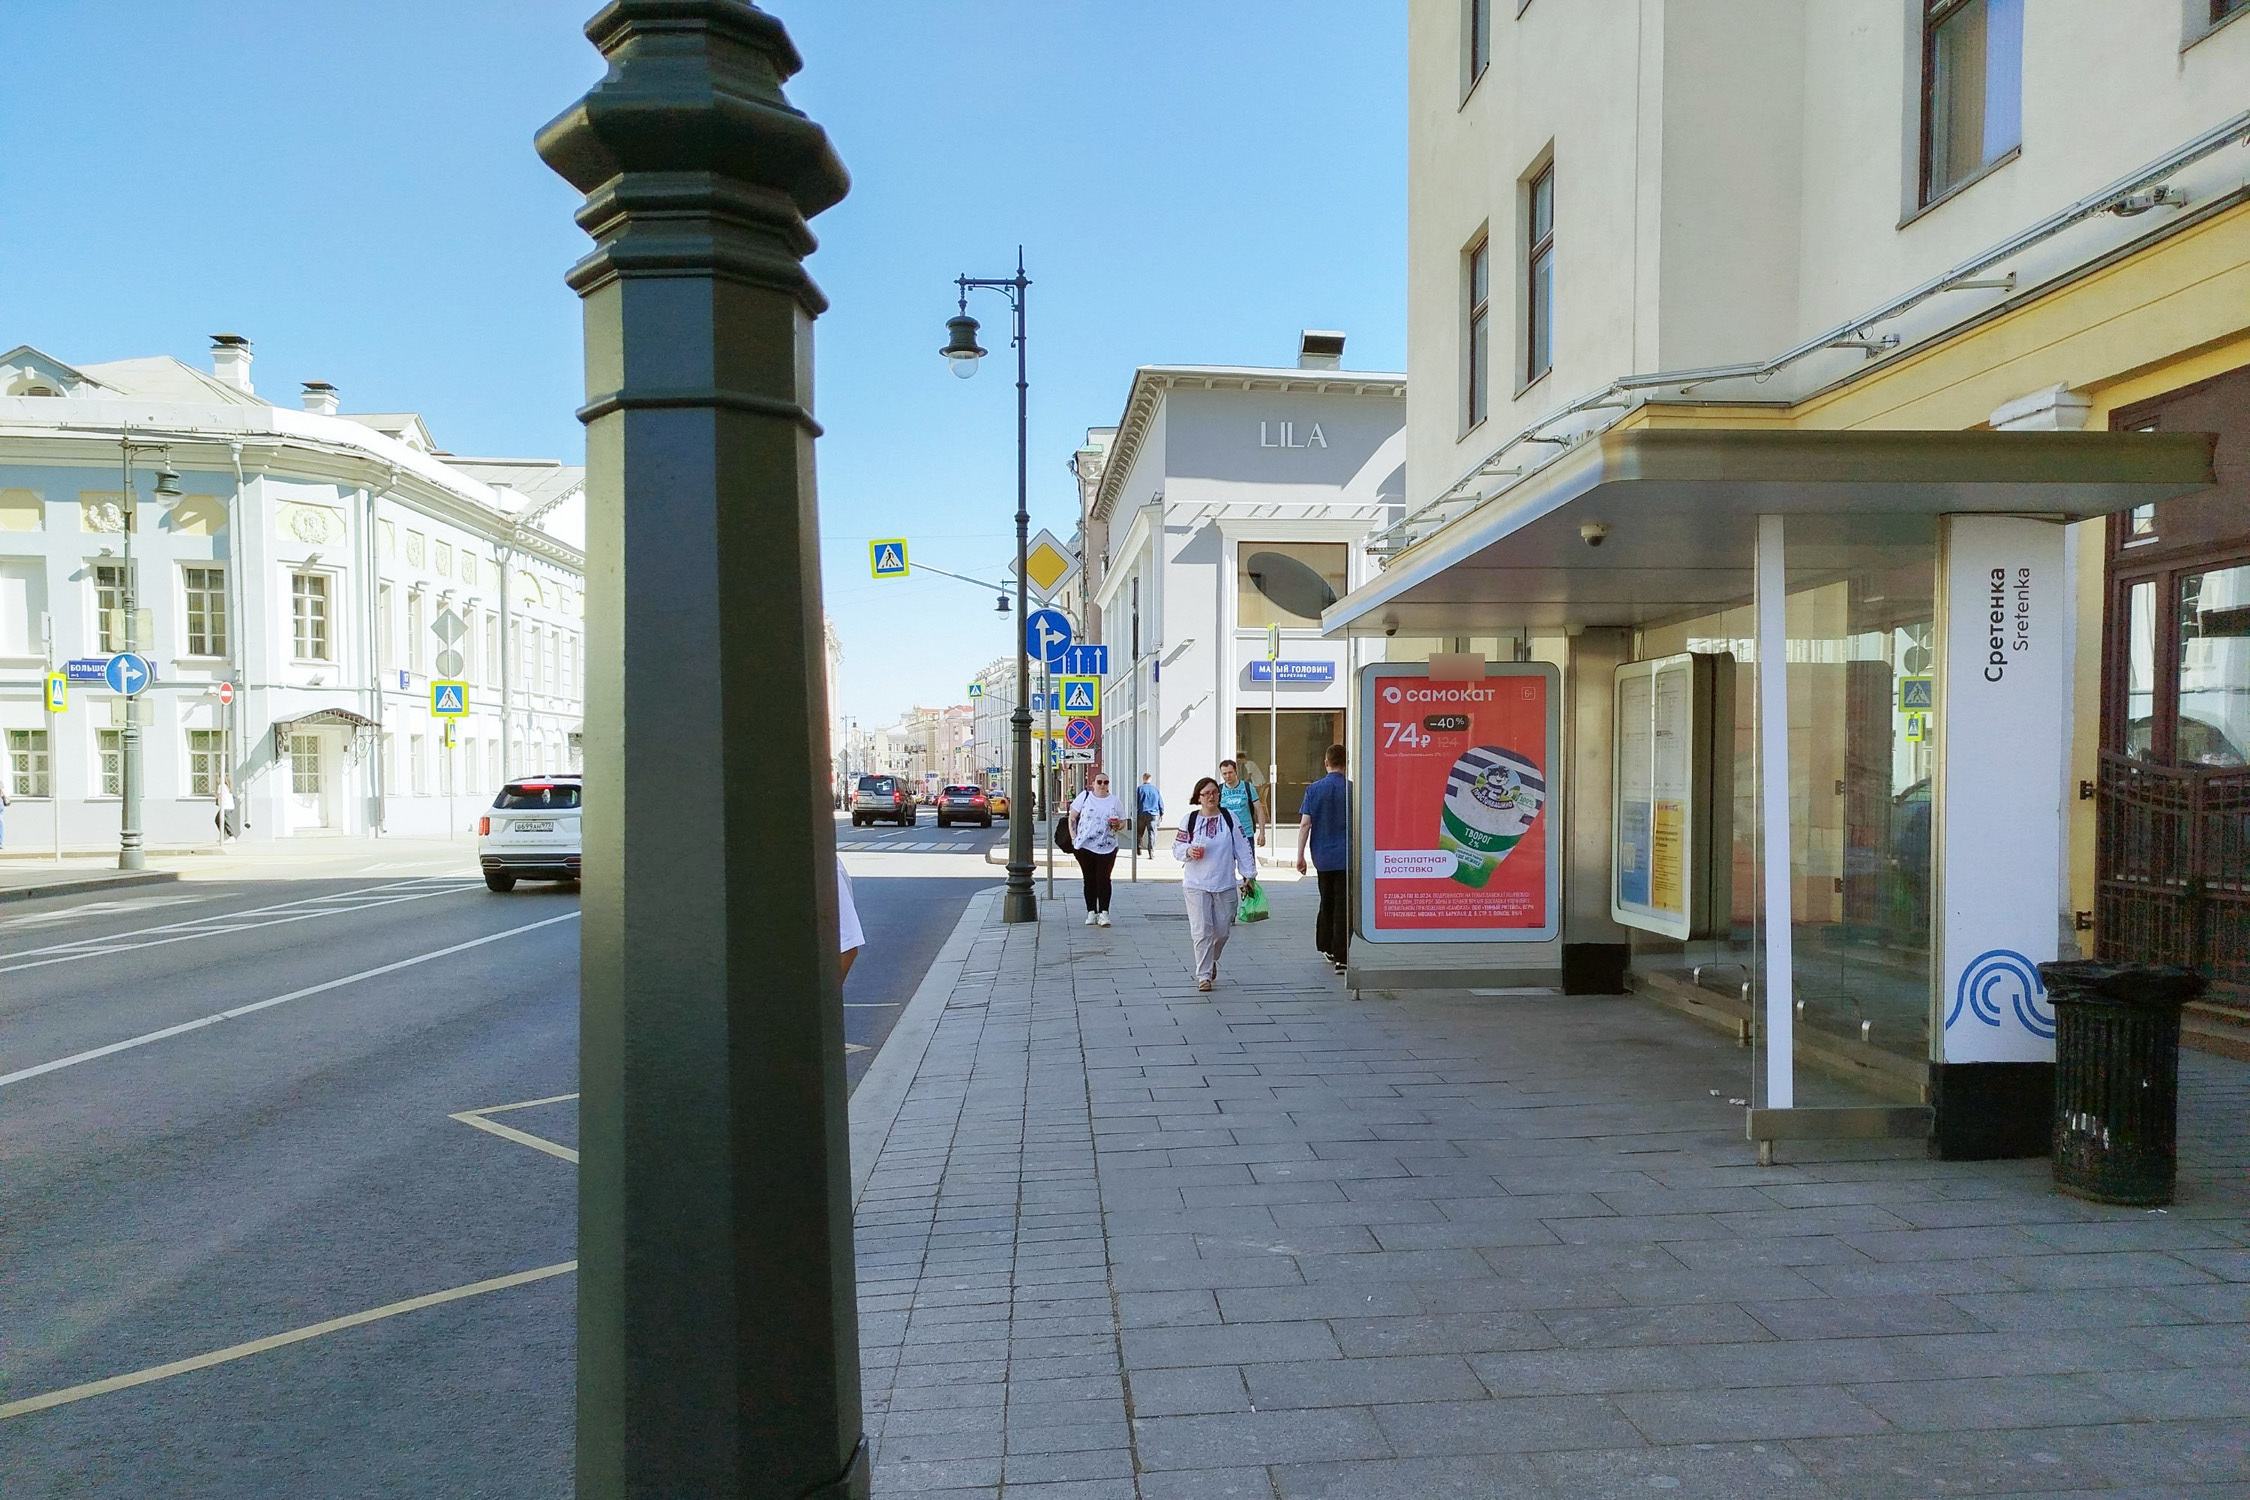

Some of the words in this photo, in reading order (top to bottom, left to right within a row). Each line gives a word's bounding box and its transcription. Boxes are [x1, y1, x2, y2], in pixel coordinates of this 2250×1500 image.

[1260, 421, 1328, 448] LILA
[2012, 567, 2030, 651] Sretenka
[1984, 567, 2008, 682] Сретенка
[1259, 664, 1289, 673] МАЫЙ
[1291, 665, 1328, 674] ГОЛОВИН
[1406, 688, 1496, 702] самокат
[1464, 827, 1493, 845] ТВОРОГ
[1384, 854, 1447, 864] Бесплатная
[1383, 866, 1433, 874] доставка
